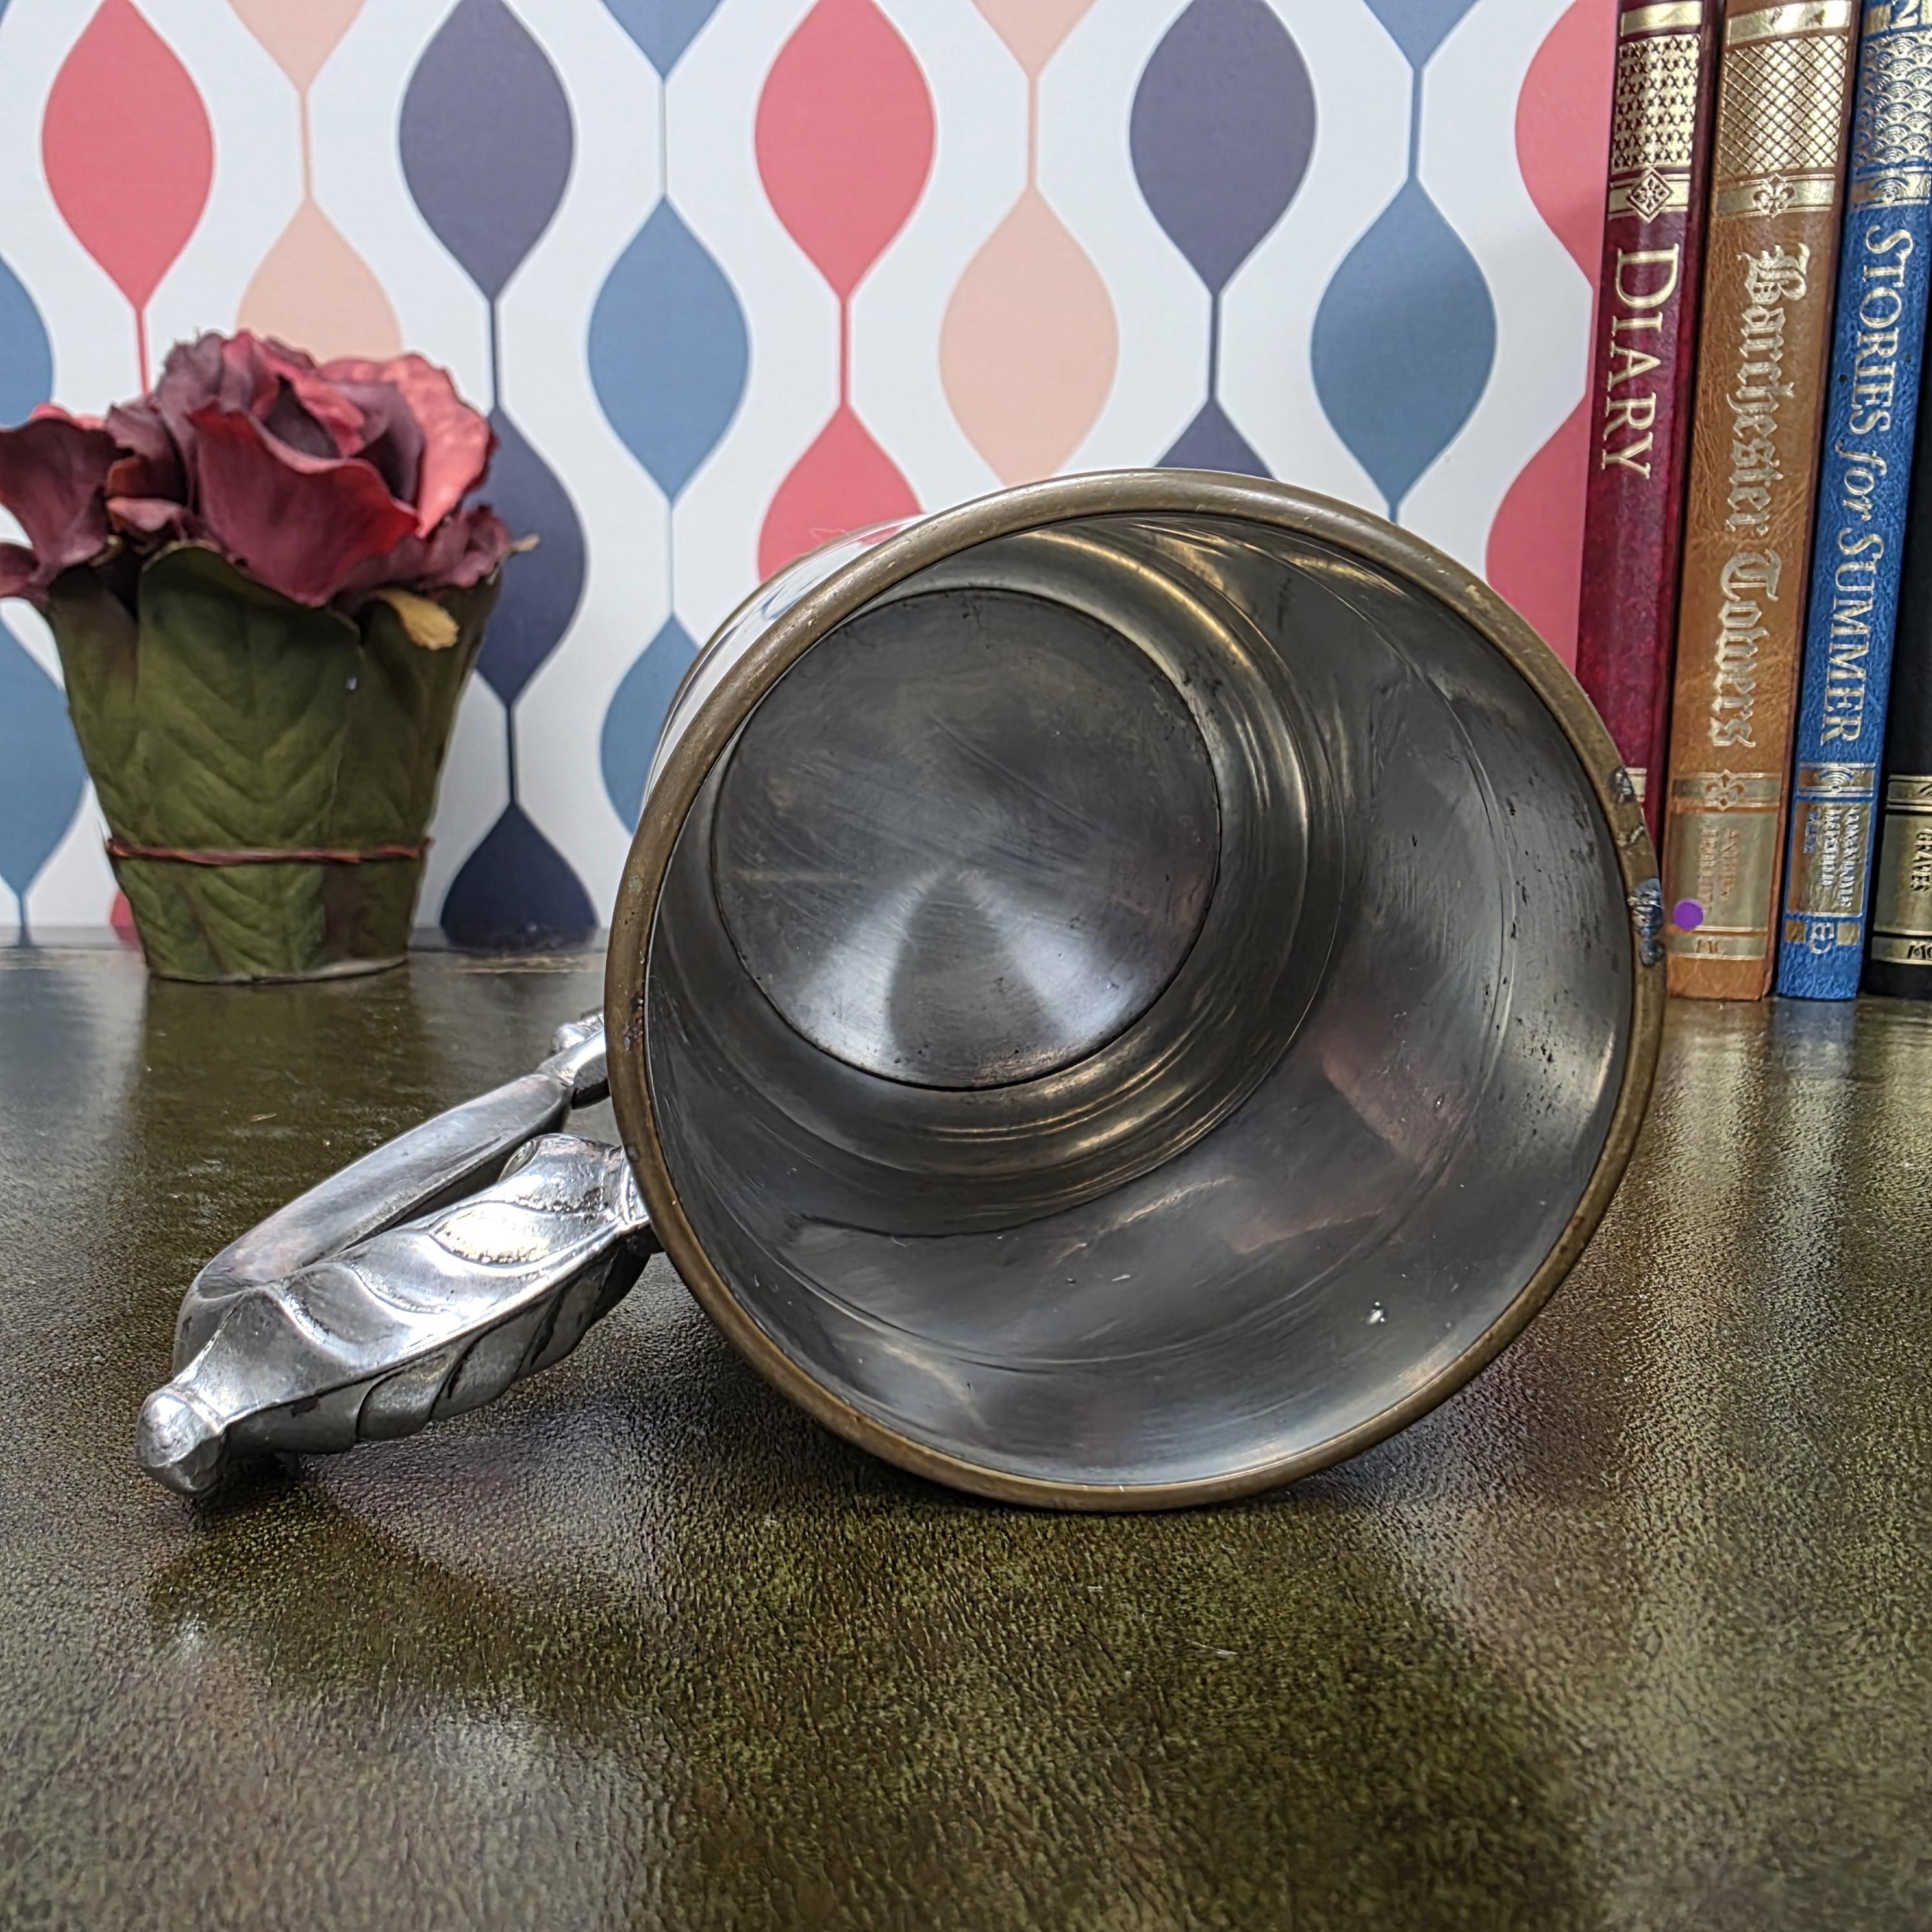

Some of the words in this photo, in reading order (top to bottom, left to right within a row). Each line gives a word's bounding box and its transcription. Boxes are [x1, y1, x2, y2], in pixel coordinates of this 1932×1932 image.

[1602, 243, 1680, 479] DIARY
[1725, 242, 1809, 535] Barchester
[1849, 224, 1914, 435] STORIES
[1834, 438, 1887, 522] for
[1707, 548, 1782, 748] Towers
[1820, 527, 1884, 746] SUMMER
